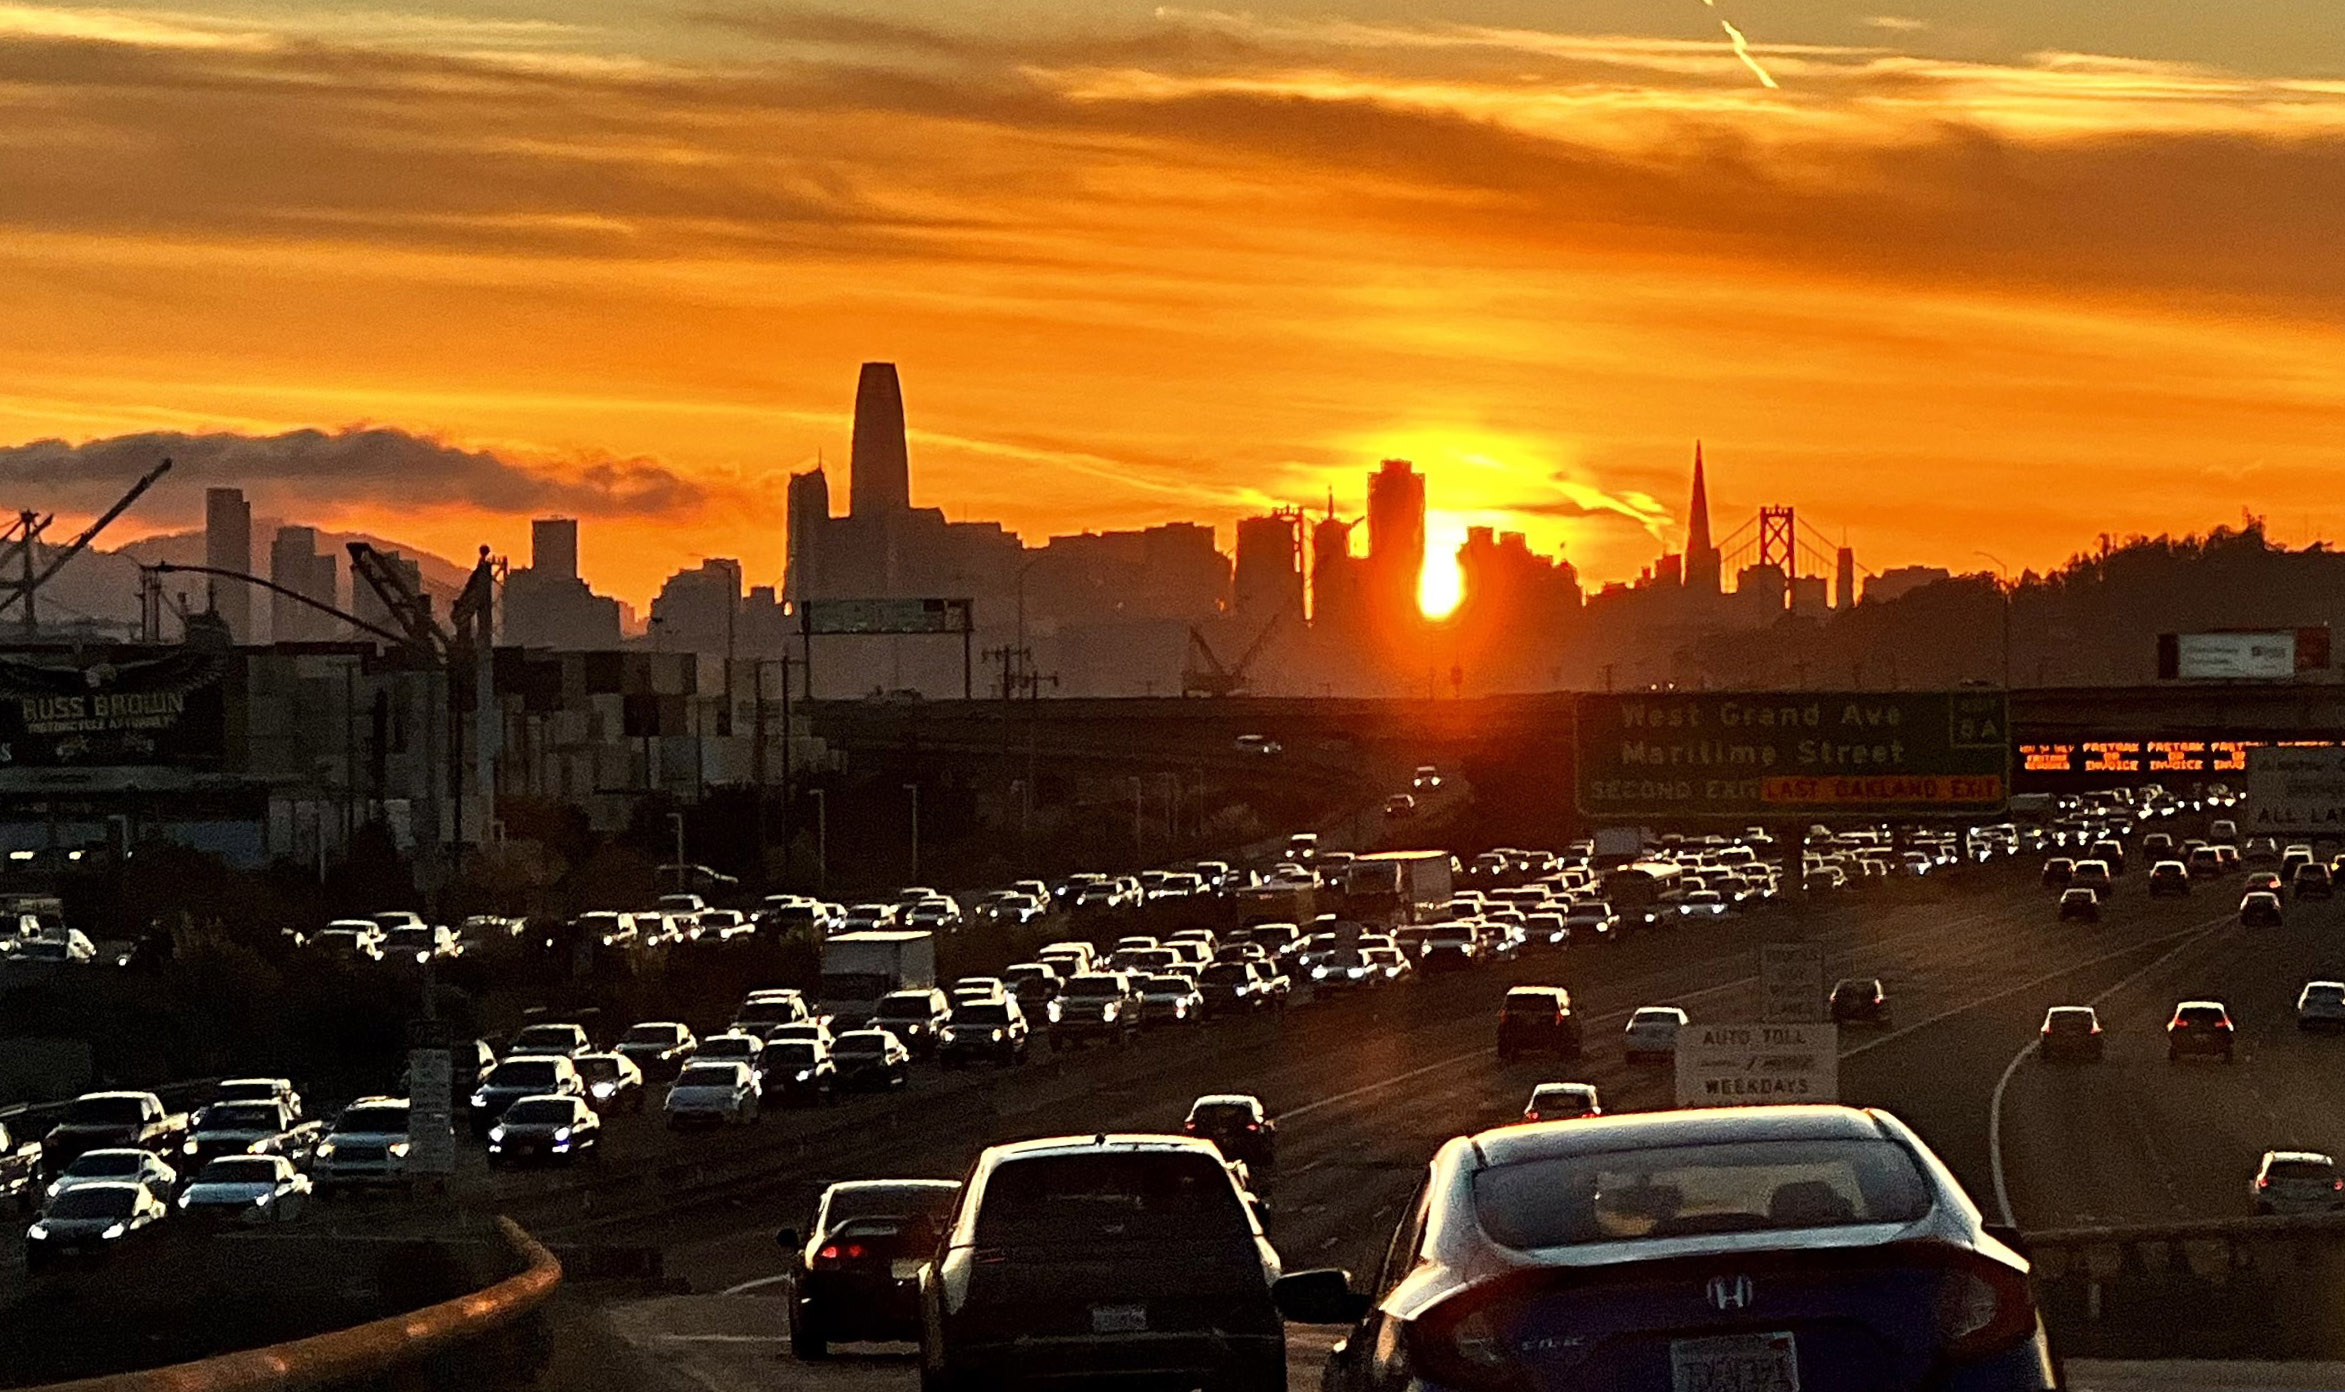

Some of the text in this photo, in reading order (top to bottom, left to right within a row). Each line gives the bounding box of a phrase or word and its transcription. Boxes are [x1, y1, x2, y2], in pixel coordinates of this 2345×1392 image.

[22, 692, 184, 720] RUSS BROWN
[1621, 701, 1903, 727] West Grand Ave
[1621, 739, 1905, 766] Maritime Street
[2085, 760, 2139, 771] INVOICE
[2150, 760, 2203, 771] INVOICE
[1590, 778, 1996, 800] SECOND EXIT LAST OAKLAND EXIT
[1703, 1028, 1807, 1045] AUTO TOLL
[1705, 1078, 1809, 1095] WEEKDAYS
